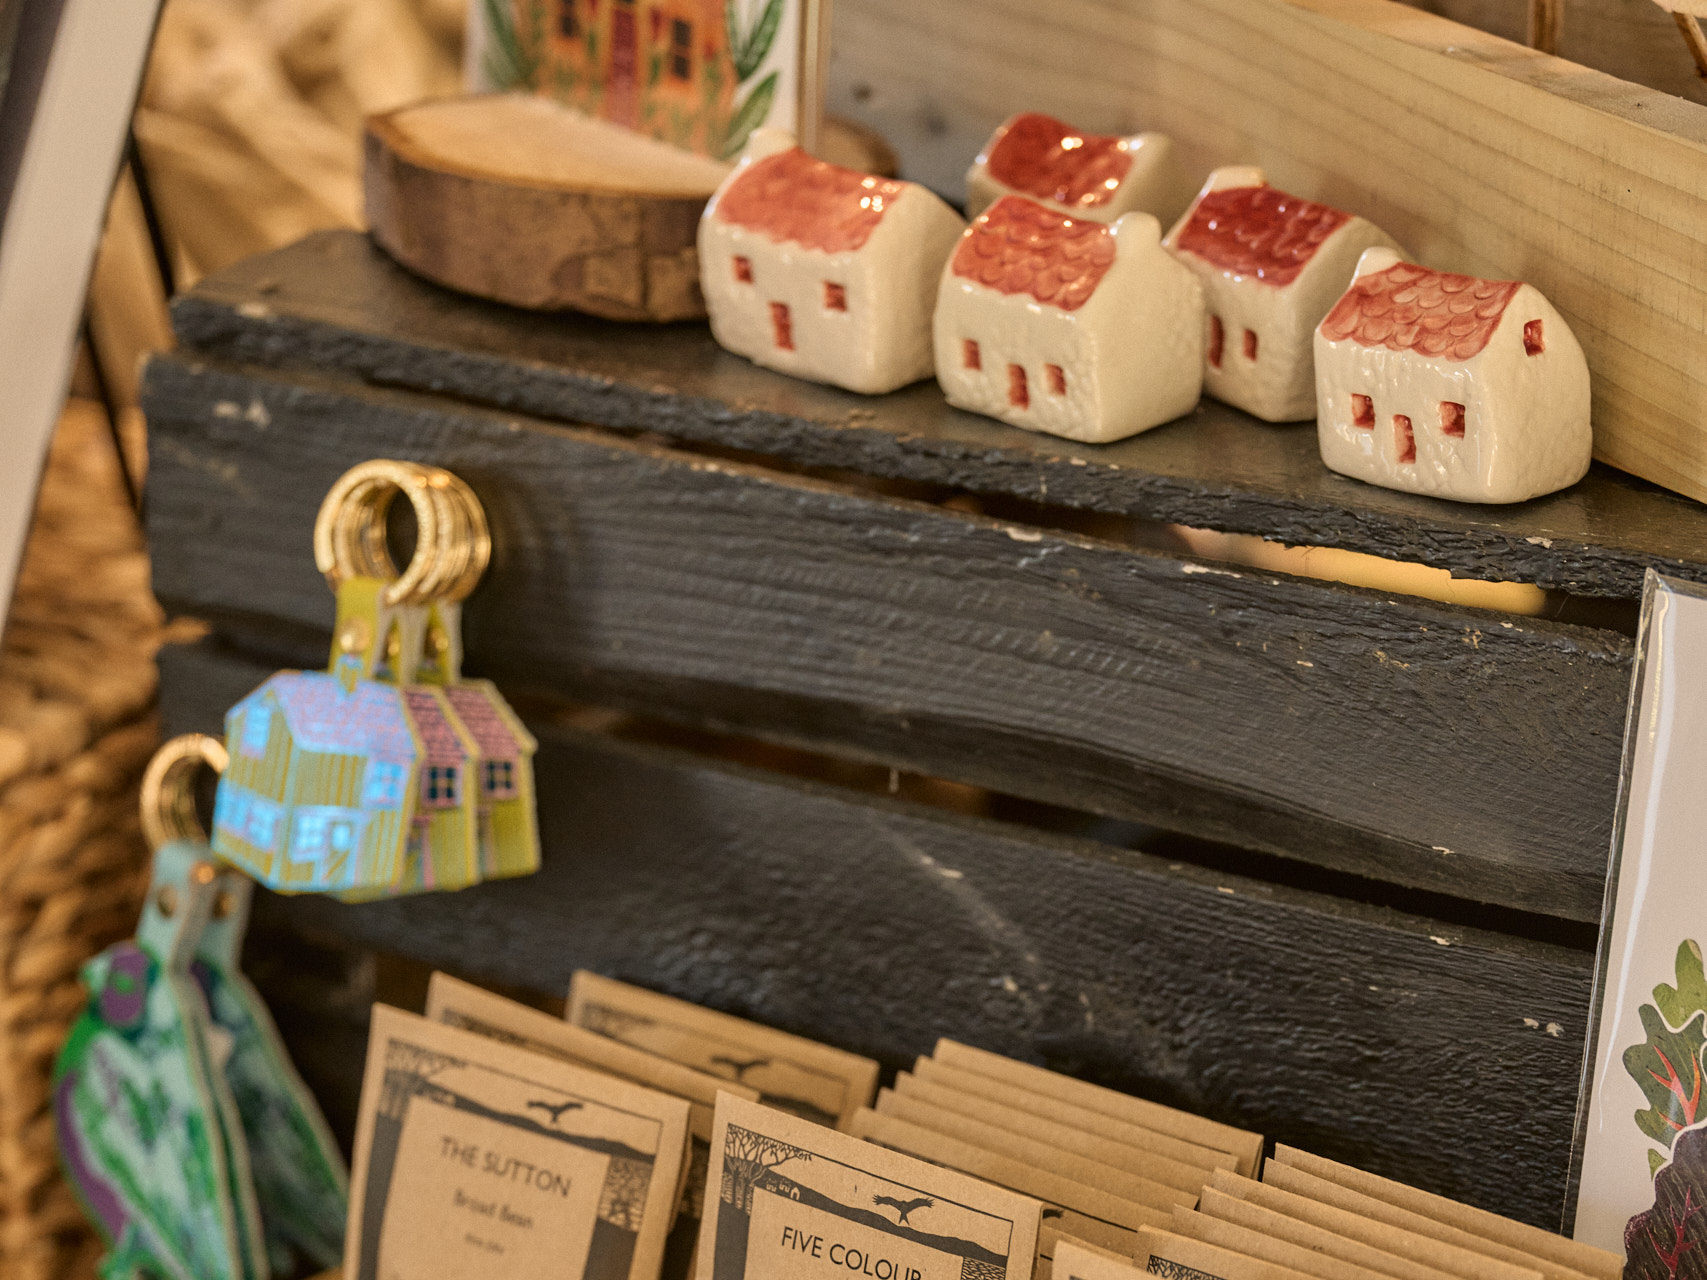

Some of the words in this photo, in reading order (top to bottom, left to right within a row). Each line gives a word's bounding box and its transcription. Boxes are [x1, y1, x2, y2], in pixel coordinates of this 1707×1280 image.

[441, 1135, 480, 1168] THE
[482, 1152, 572, 1197] SUTTON
[781, 1226, 824, 1258] FIVE
